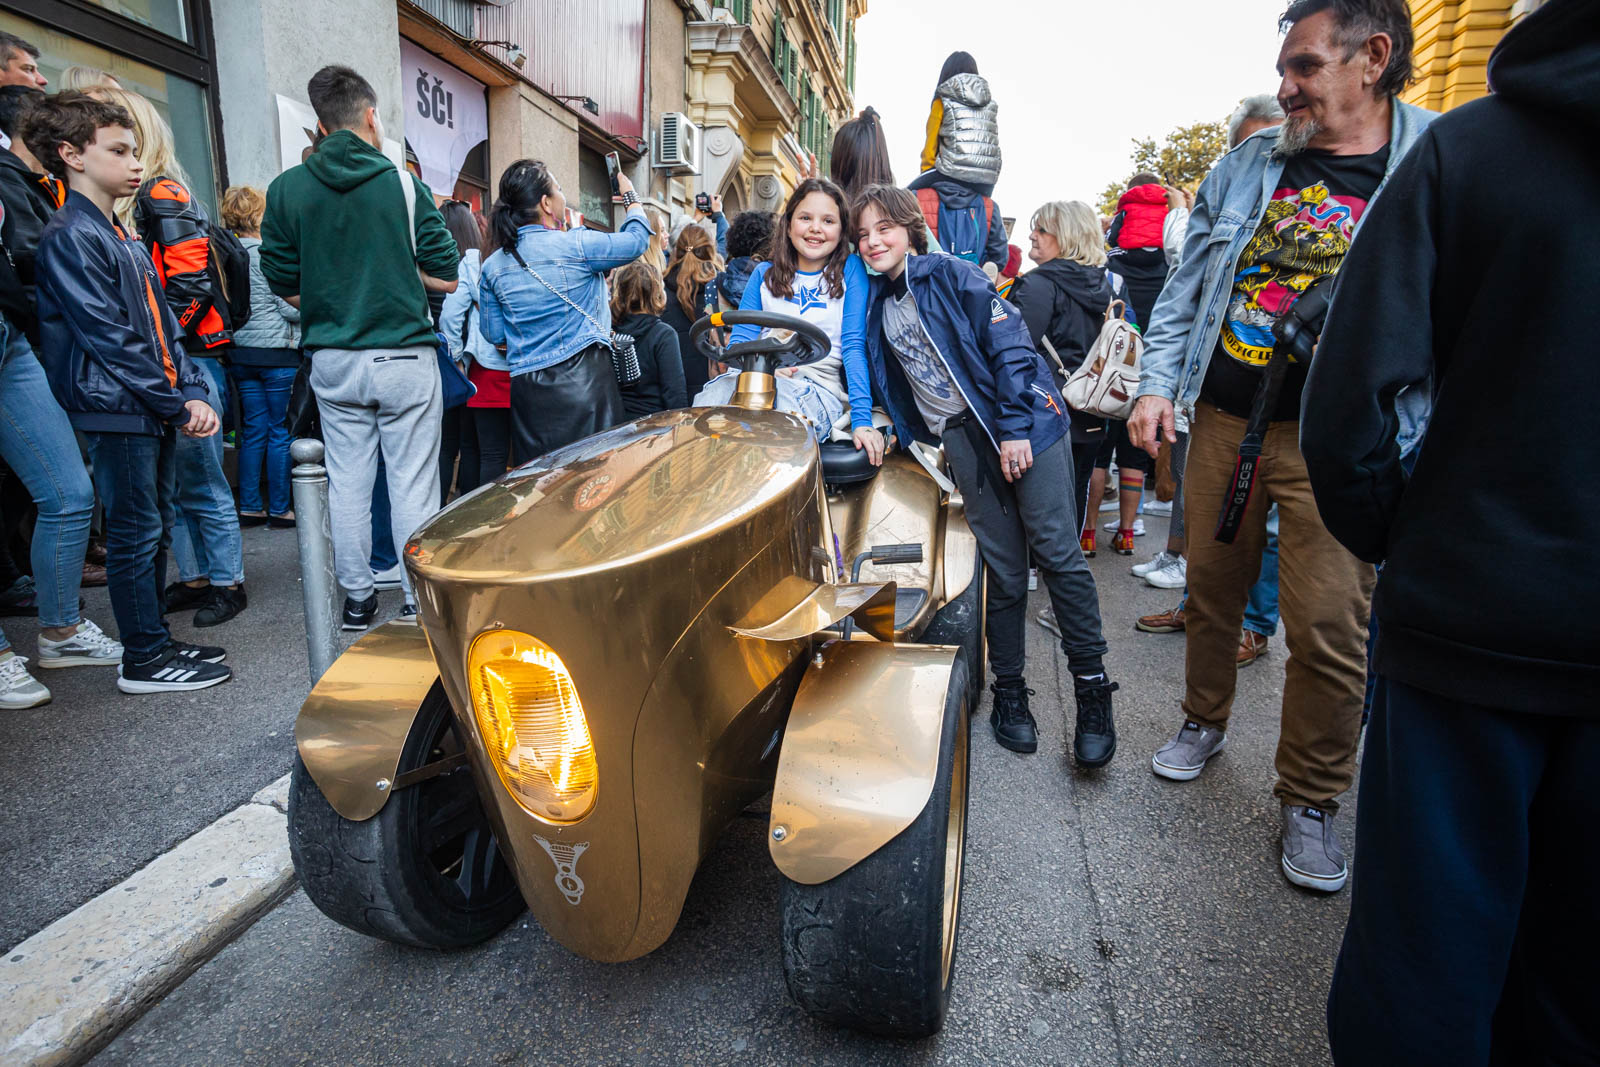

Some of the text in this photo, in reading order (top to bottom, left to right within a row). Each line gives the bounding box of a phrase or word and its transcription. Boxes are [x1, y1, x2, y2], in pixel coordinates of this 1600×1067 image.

[416, 67, 454, 129] ŠČ!
[1234, 462, 1253, 505] EOS 5D
